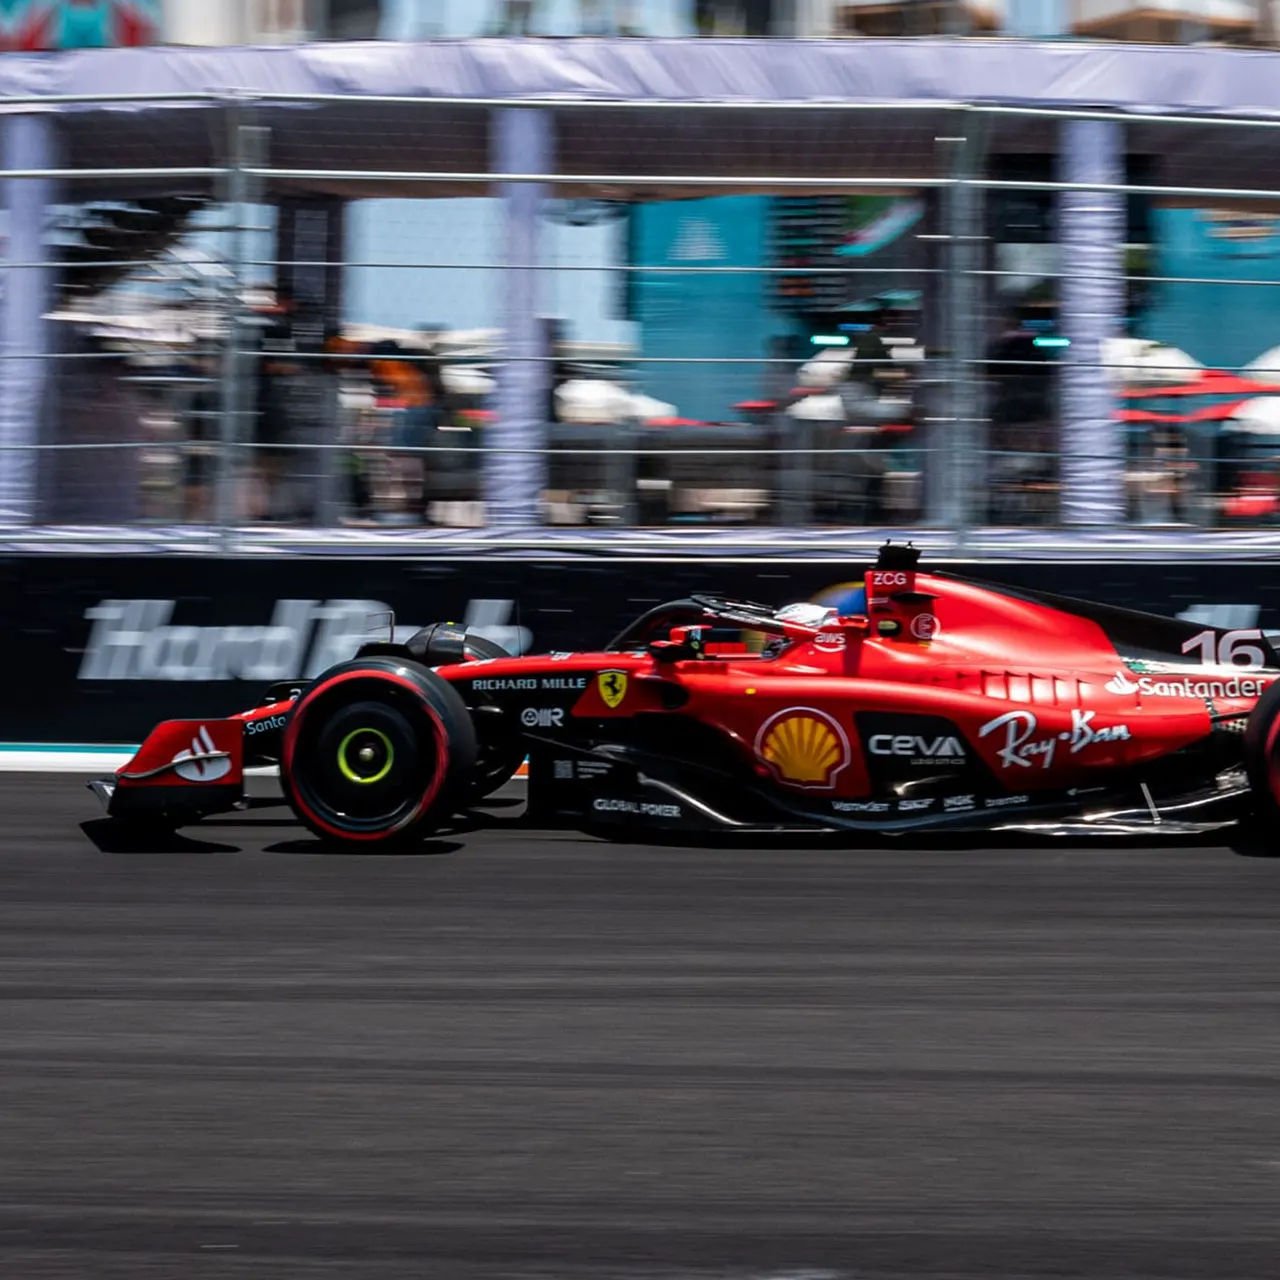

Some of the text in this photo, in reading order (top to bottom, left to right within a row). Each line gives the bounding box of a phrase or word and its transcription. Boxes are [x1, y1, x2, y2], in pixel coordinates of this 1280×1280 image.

[873, 572, 907, 585] ZCG
[814, 632, 846, 644] aws
[1181, 629, 1265, 669] 16
[472, 677, 587, 690] RICHARD MILLE
[1138, 676, 1267, 698] Santander
[246, 716, 287, 735] Santa
